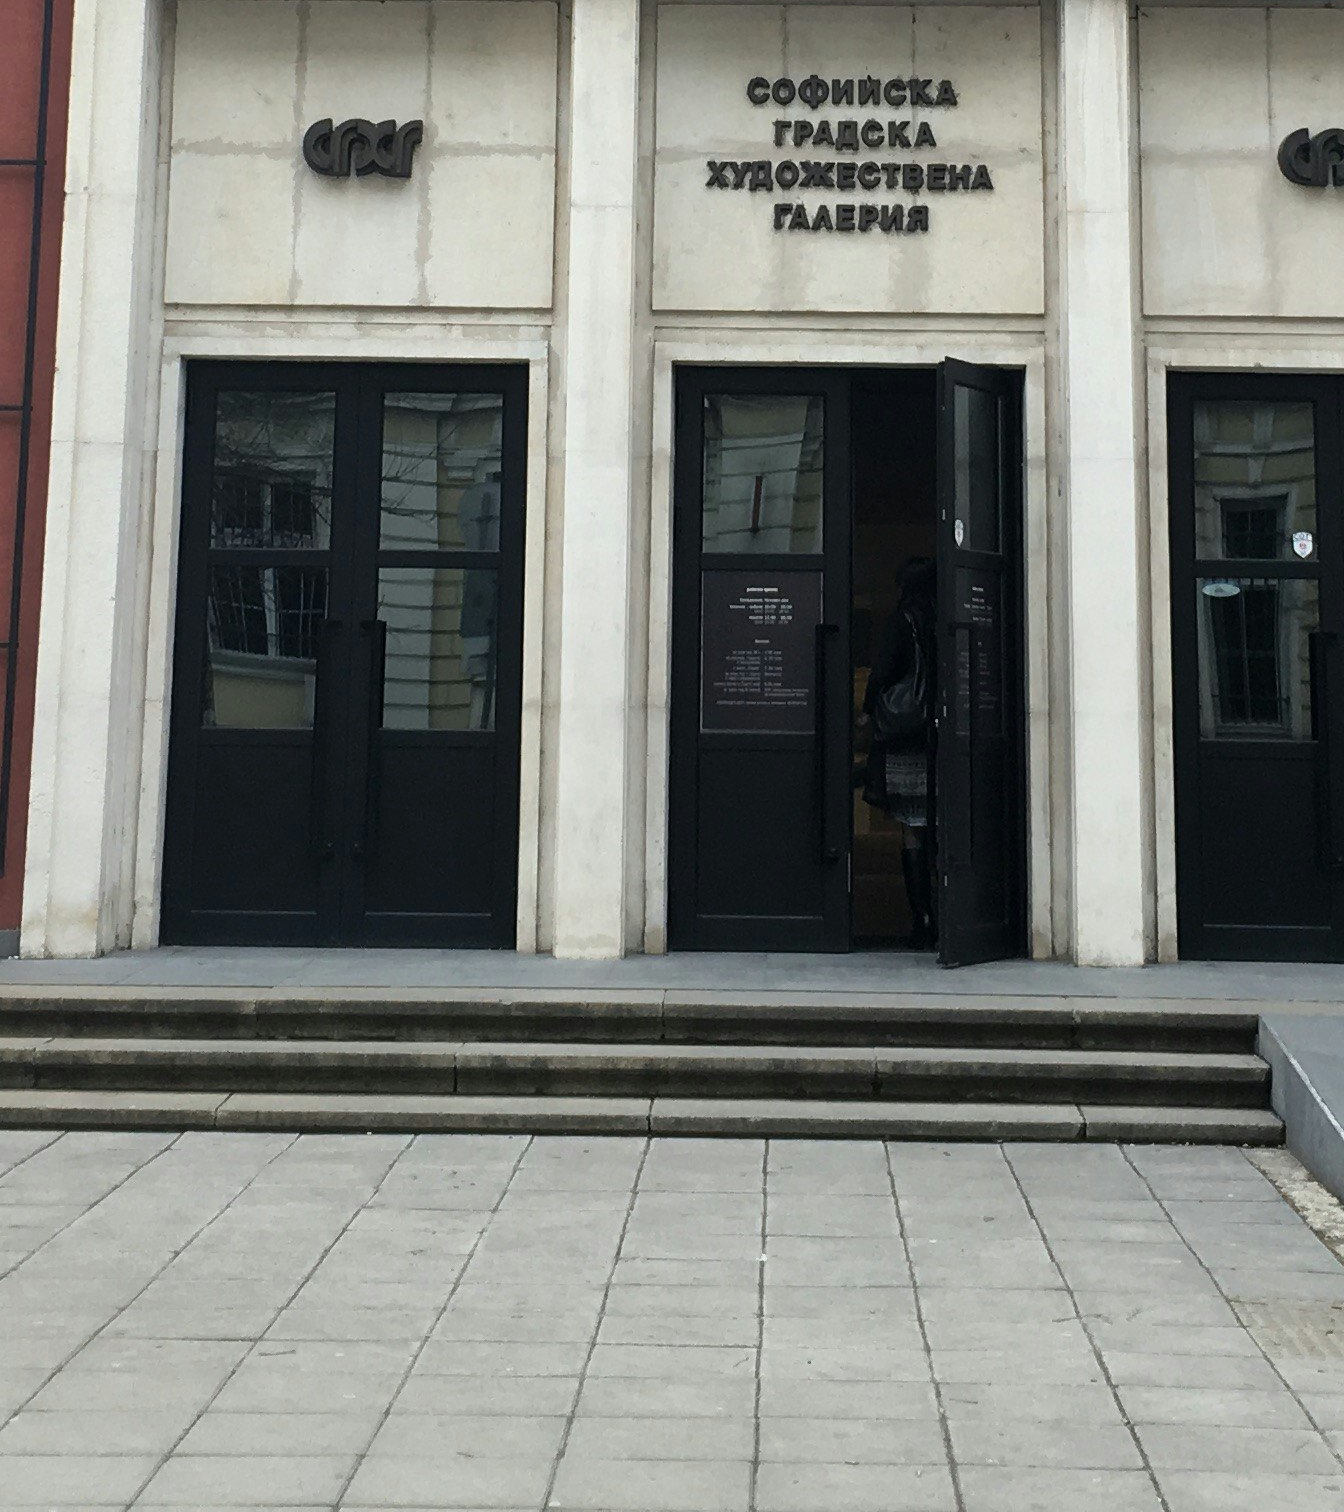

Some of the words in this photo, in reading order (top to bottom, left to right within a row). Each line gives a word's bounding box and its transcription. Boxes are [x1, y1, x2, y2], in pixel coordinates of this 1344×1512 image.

[746, 75, 958, 108] СОФИЙСКА
[773, 120, 937, 151] ГРАДСКА
[706, 160, 994, 192] ХУДОЖЕСТВЕНА
[773, 203, 929, 232] ГАЛЕРИЯ
